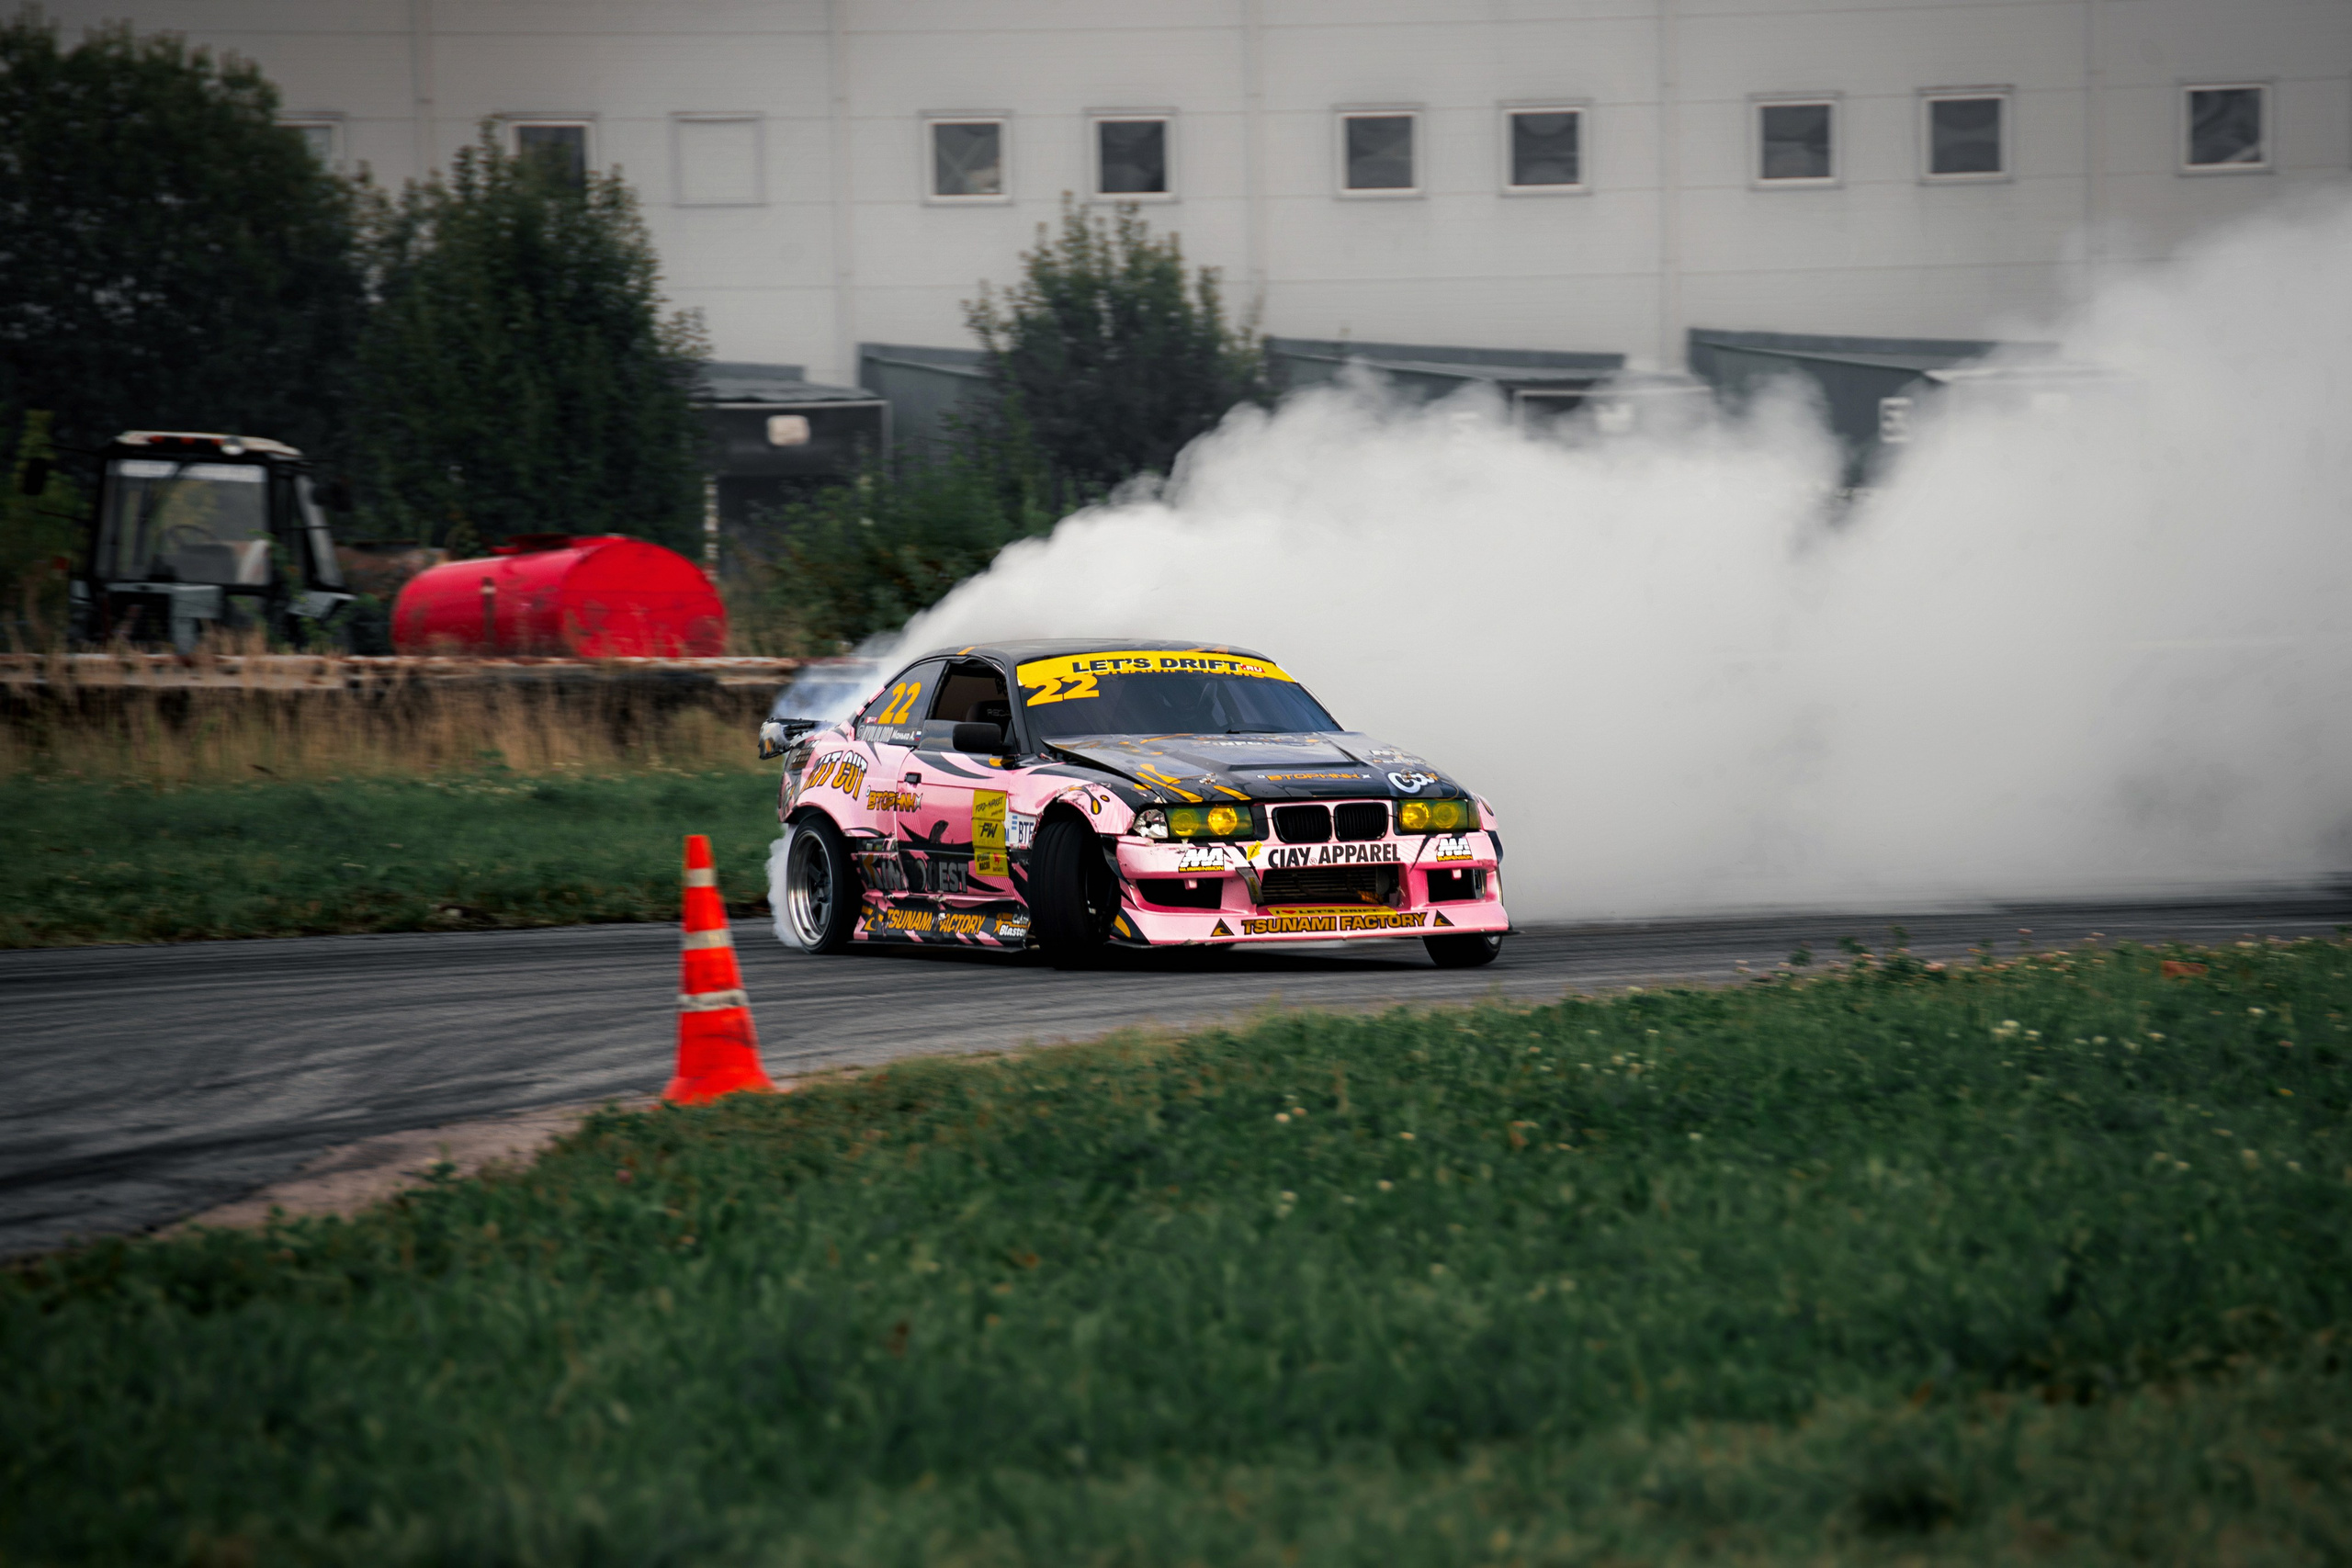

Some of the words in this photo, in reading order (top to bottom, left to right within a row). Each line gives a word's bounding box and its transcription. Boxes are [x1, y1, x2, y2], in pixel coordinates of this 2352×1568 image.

[1072, 657, 1152, 673] LET'S
[1023, 674, 1100, 707] 22
[877, 682, 922, 724] 22
[1318, 843, 1401, 864] APPAREL
[1241, 915, 1337, 935] TSUNAMI
[1340, 911, 1428, 931] FACTORY
